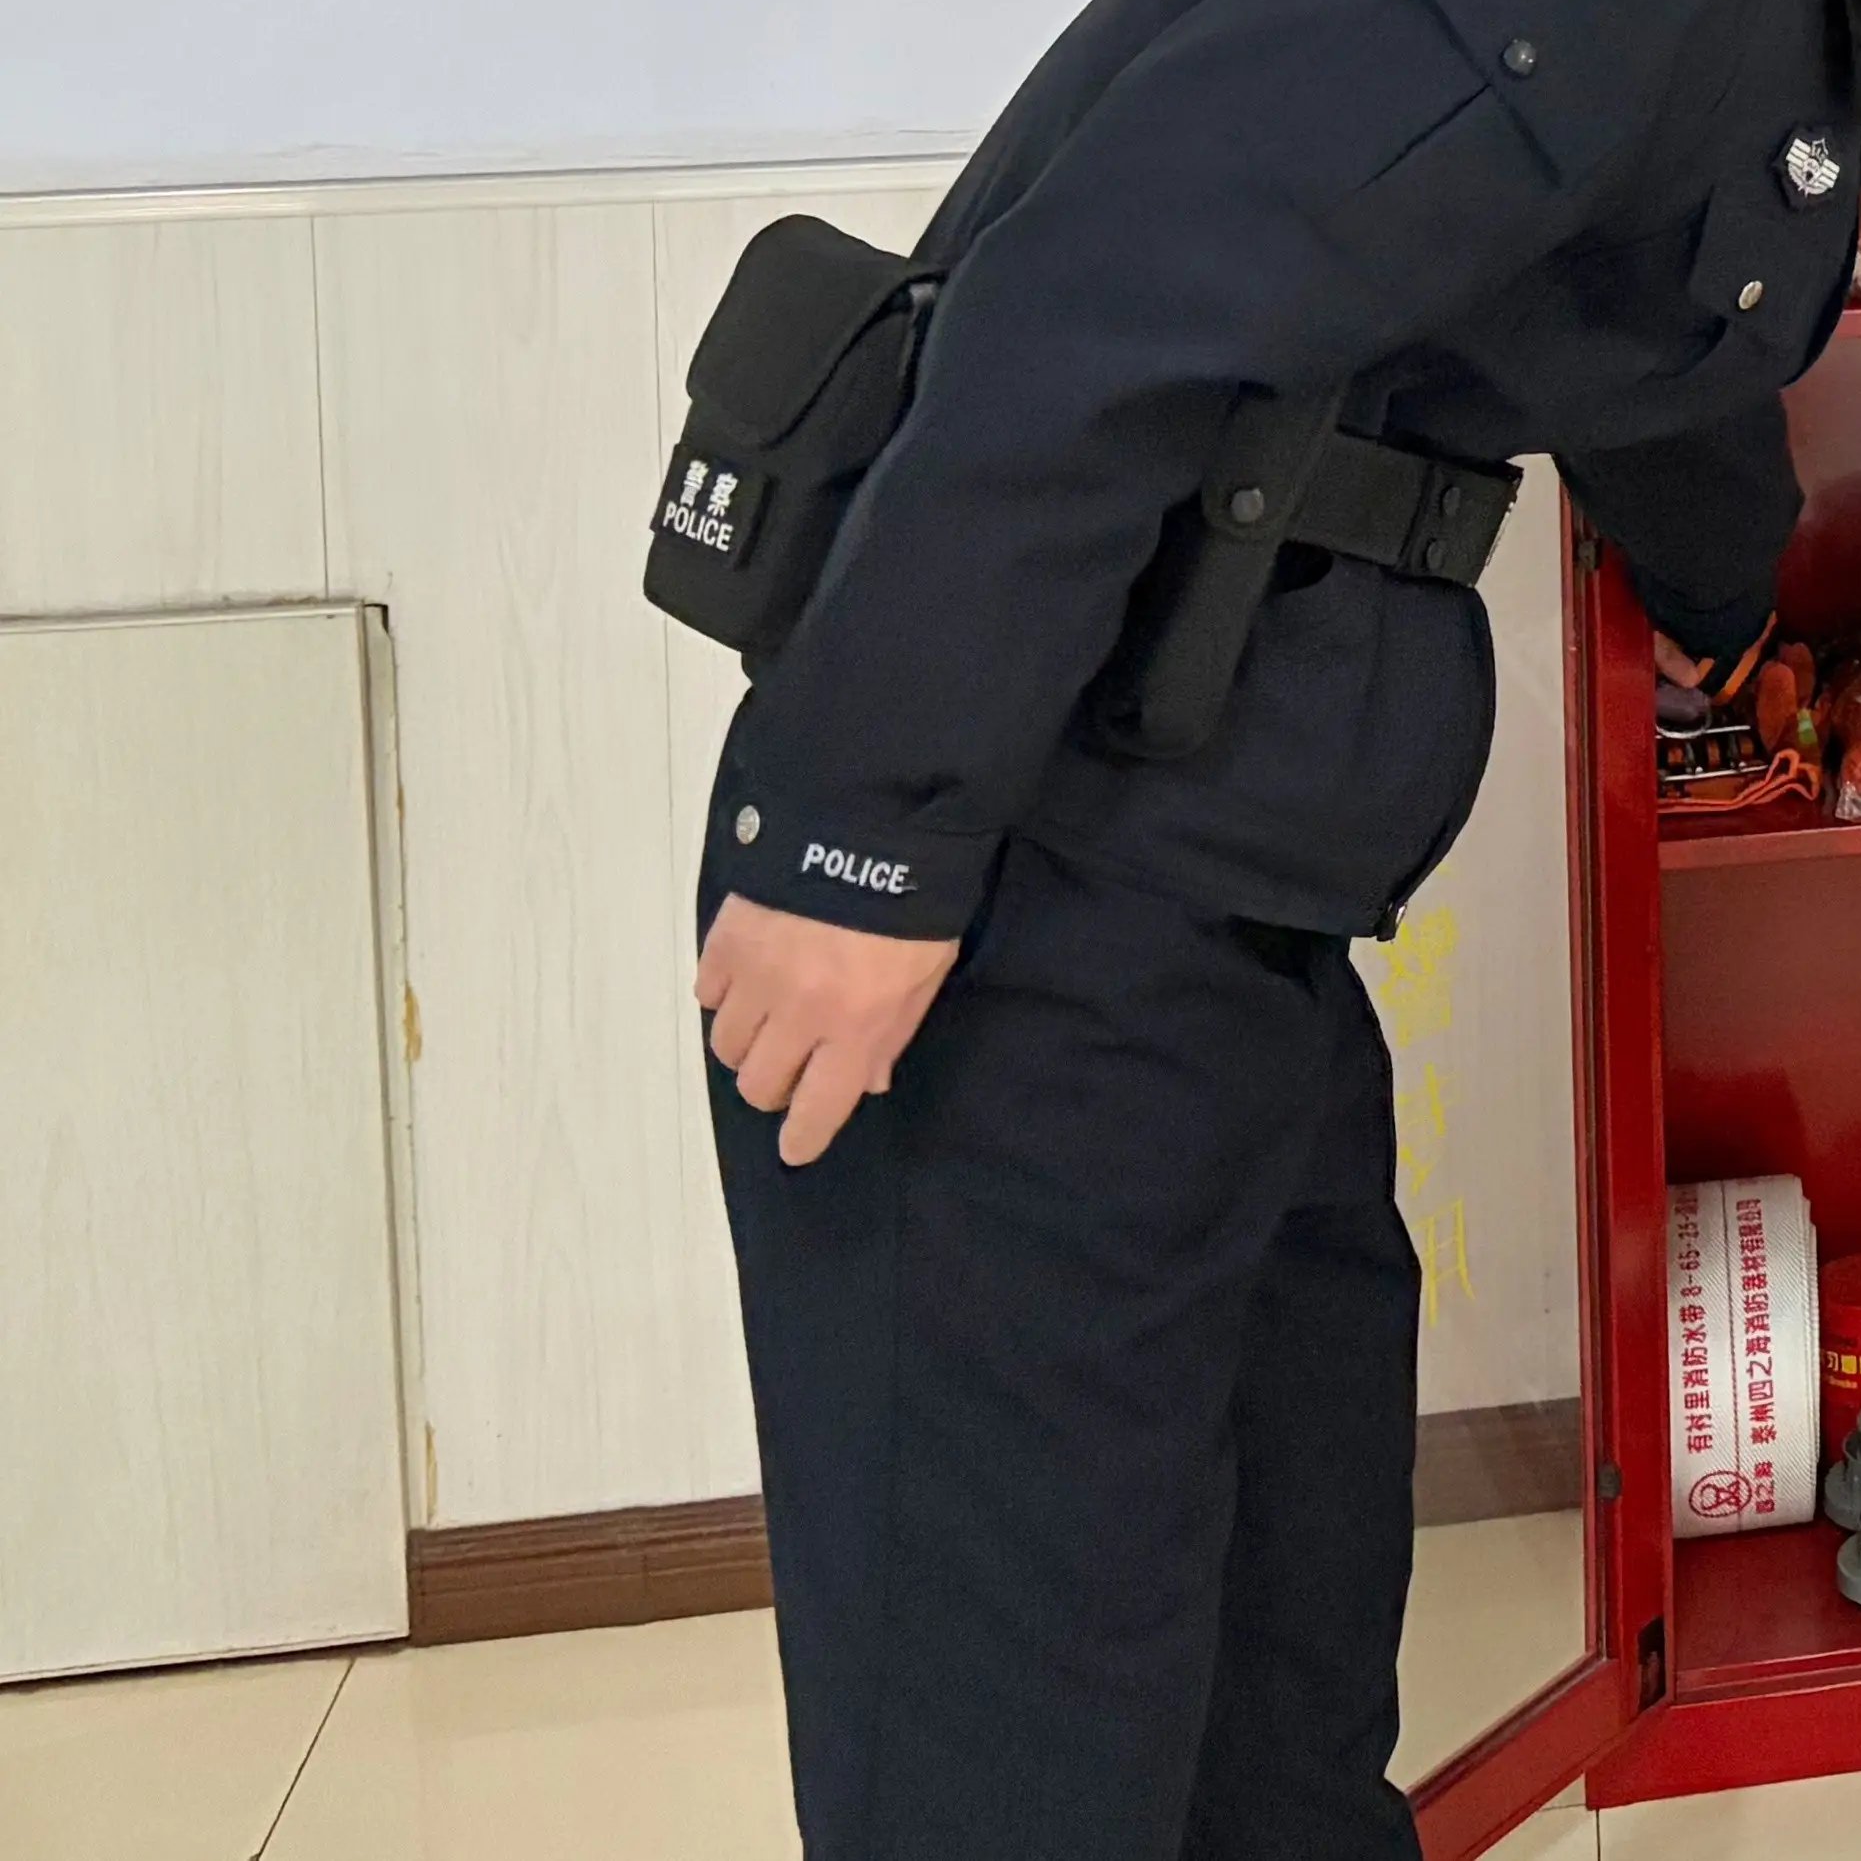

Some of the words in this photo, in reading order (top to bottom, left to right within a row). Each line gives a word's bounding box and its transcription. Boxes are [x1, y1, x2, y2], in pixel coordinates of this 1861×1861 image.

[680, 459, 739, 517] 警察
[663, 500, 734, 552] POLICE
[801, 842, 911, 895] POLICE
